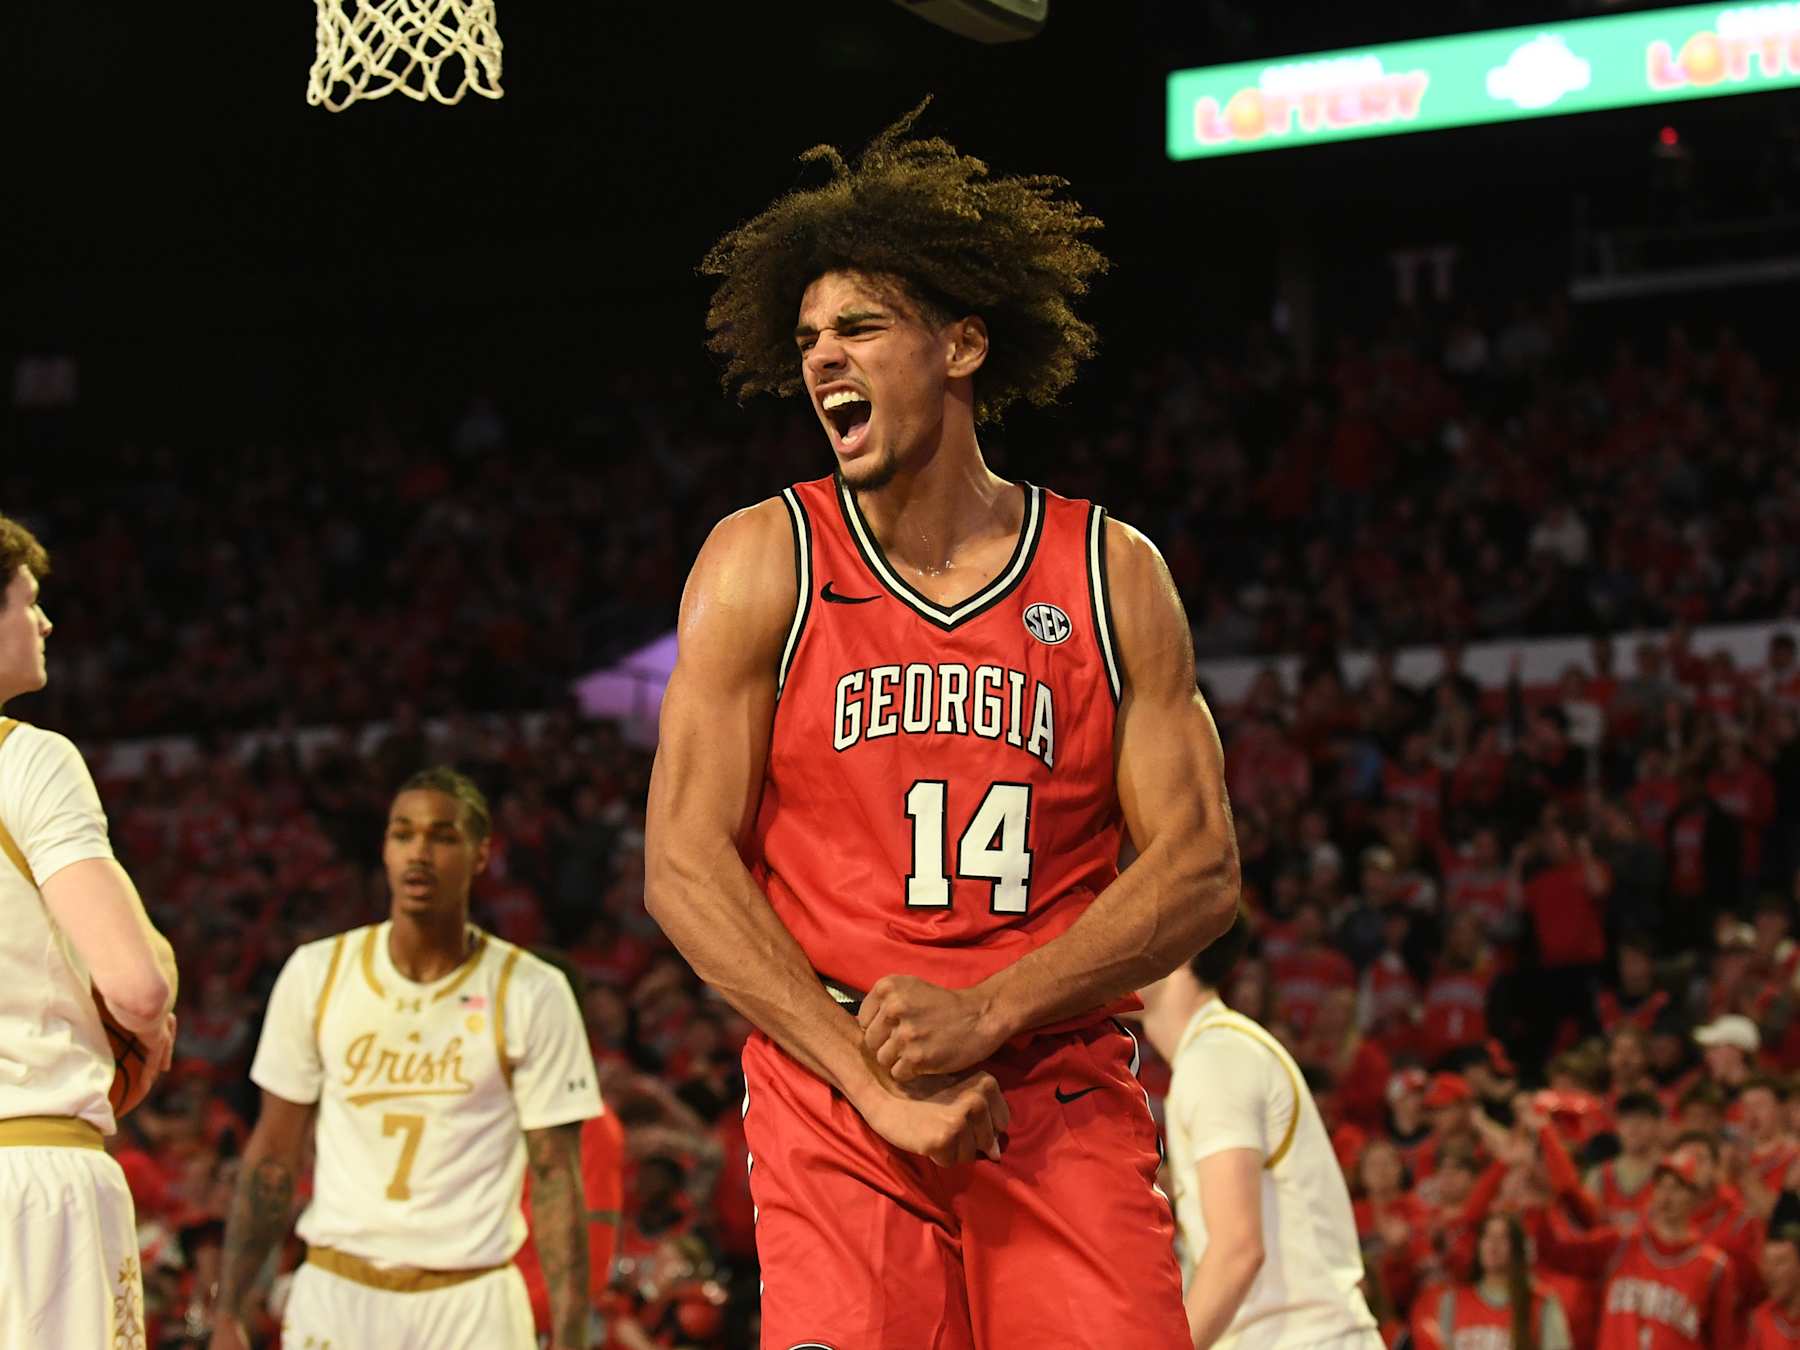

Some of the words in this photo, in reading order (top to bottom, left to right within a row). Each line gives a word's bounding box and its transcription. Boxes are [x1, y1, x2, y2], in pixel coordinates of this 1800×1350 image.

[1195, 68, 1430, 144] LOTTERY
[1027, 605, 1069, 642] SEC
[833, 663, 1055, 770] GEORGIA
[904, 780, 1033, 915] 14
[342, 1032, 474, 1104] Irish
[381, 1113, 425, 1201] 7
